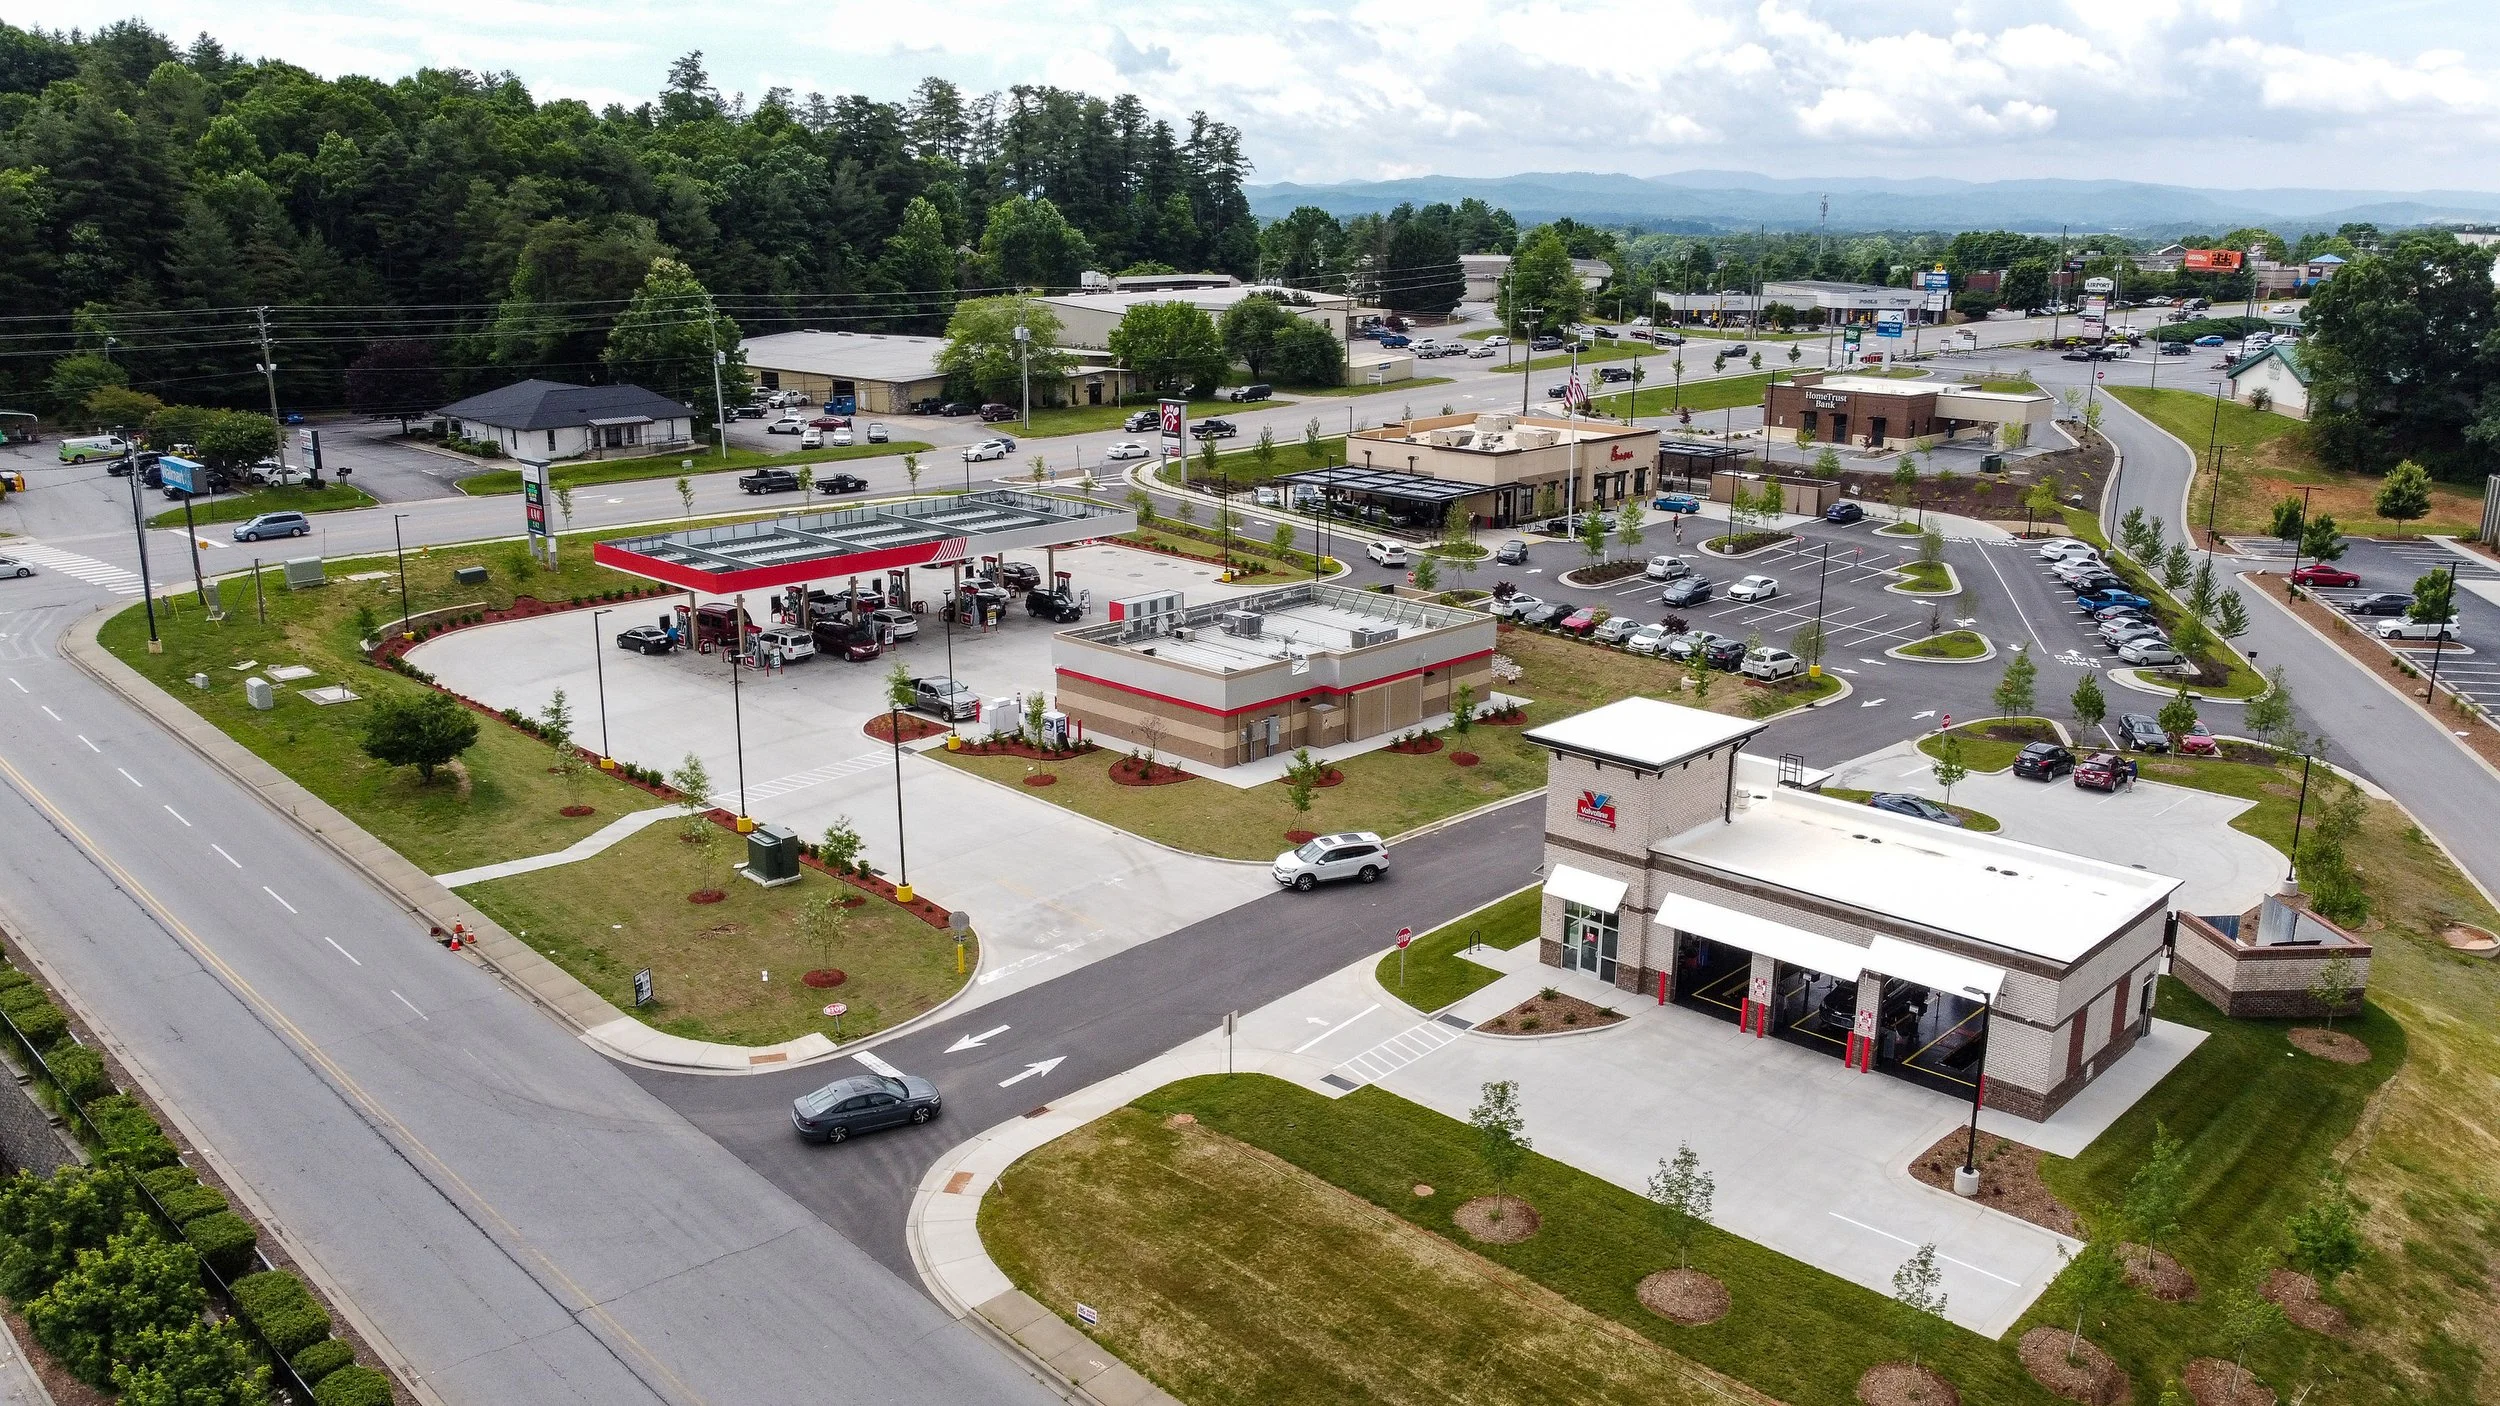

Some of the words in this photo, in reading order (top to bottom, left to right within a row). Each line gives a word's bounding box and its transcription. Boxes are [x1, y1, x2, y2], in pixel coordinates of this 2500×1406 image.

[1805, 391, 1848, 402] HomeTrust
[1815, 400, 1836, 409] Bank
[2054, 654, 2100, 664] DRIVE
[2059, 659, 2102, 669] THRU
[1580, 806, 1609, 819] Valvoline
[1397, 932, 1410, 943] STOP
[825, 1005, 845, 1014] STOP
